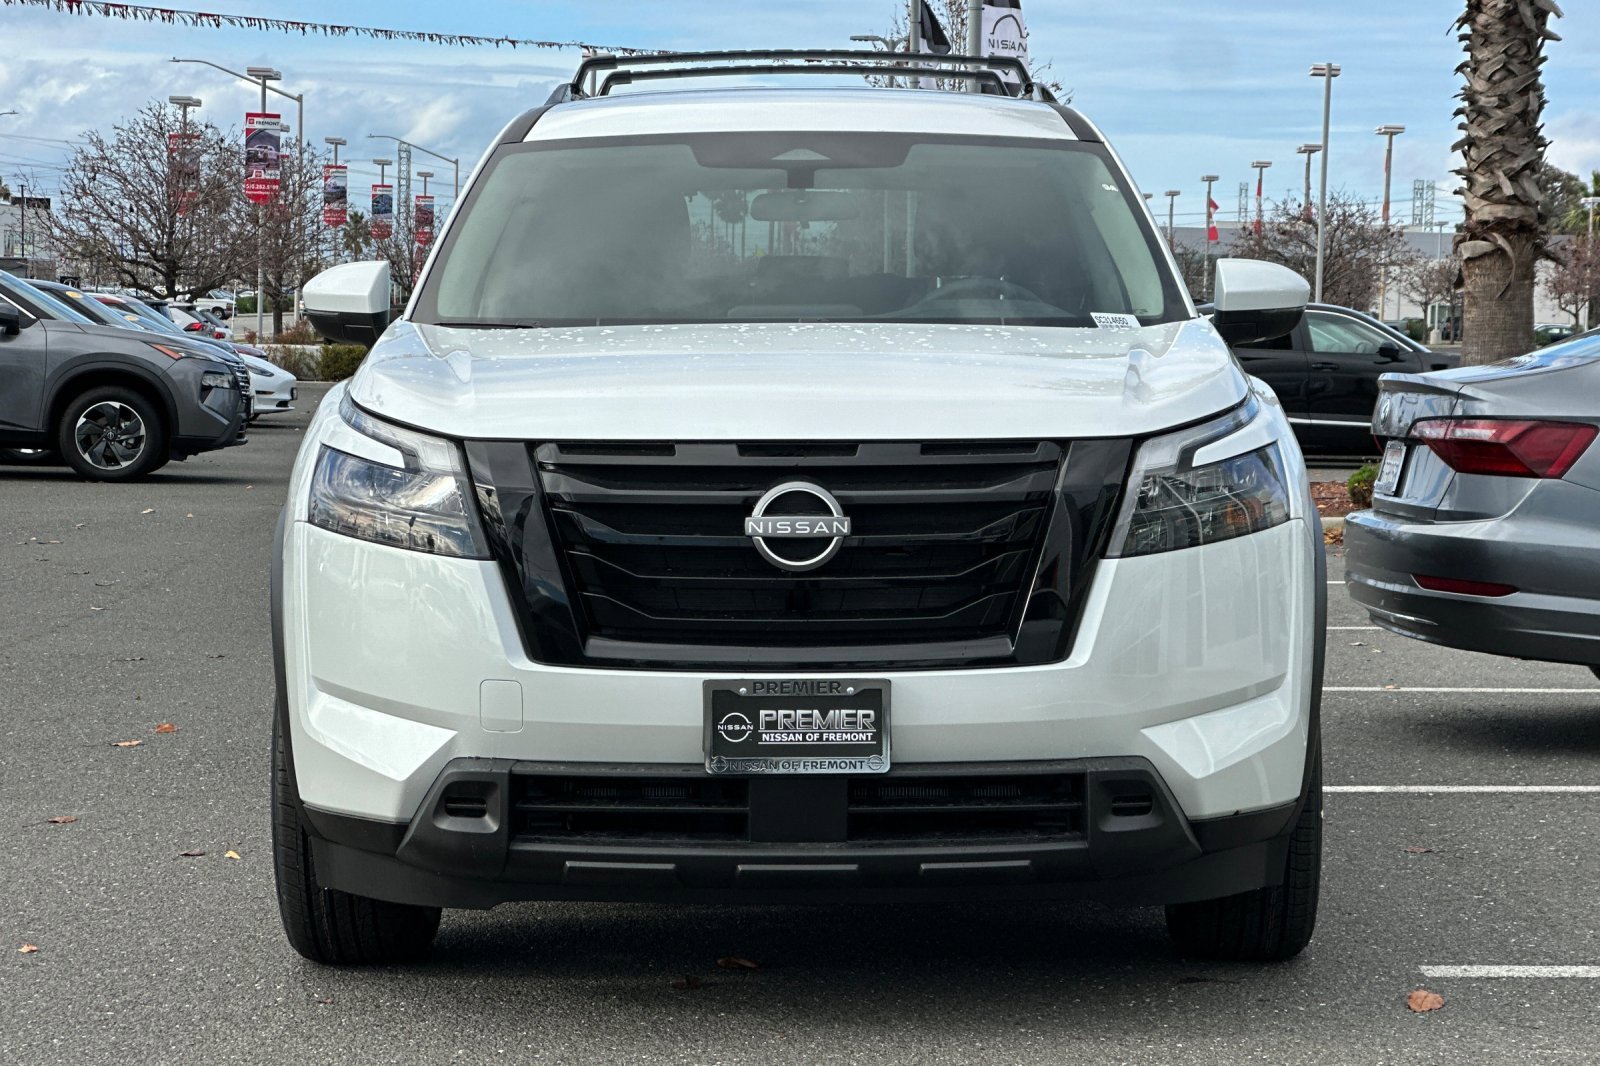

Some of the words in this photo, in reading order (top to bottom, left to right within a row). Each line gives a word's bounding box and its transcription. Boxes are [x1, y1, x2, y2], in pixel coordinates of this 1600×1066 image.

[748, 521, 848, 534] NISSAN
[752, 681, 842, 695] PREMIER
[759, 709, 876, 730] PREMIER
[762, 733, 802, 742] NISSAN
[806, 733, 820, 742] OF
[823, 732, 873, 741] FREMONT
[729, 760, 778, 772] NISSAN
[781, 760, 800, 770] OF
[803, 760, 866, 770] FREMONT
